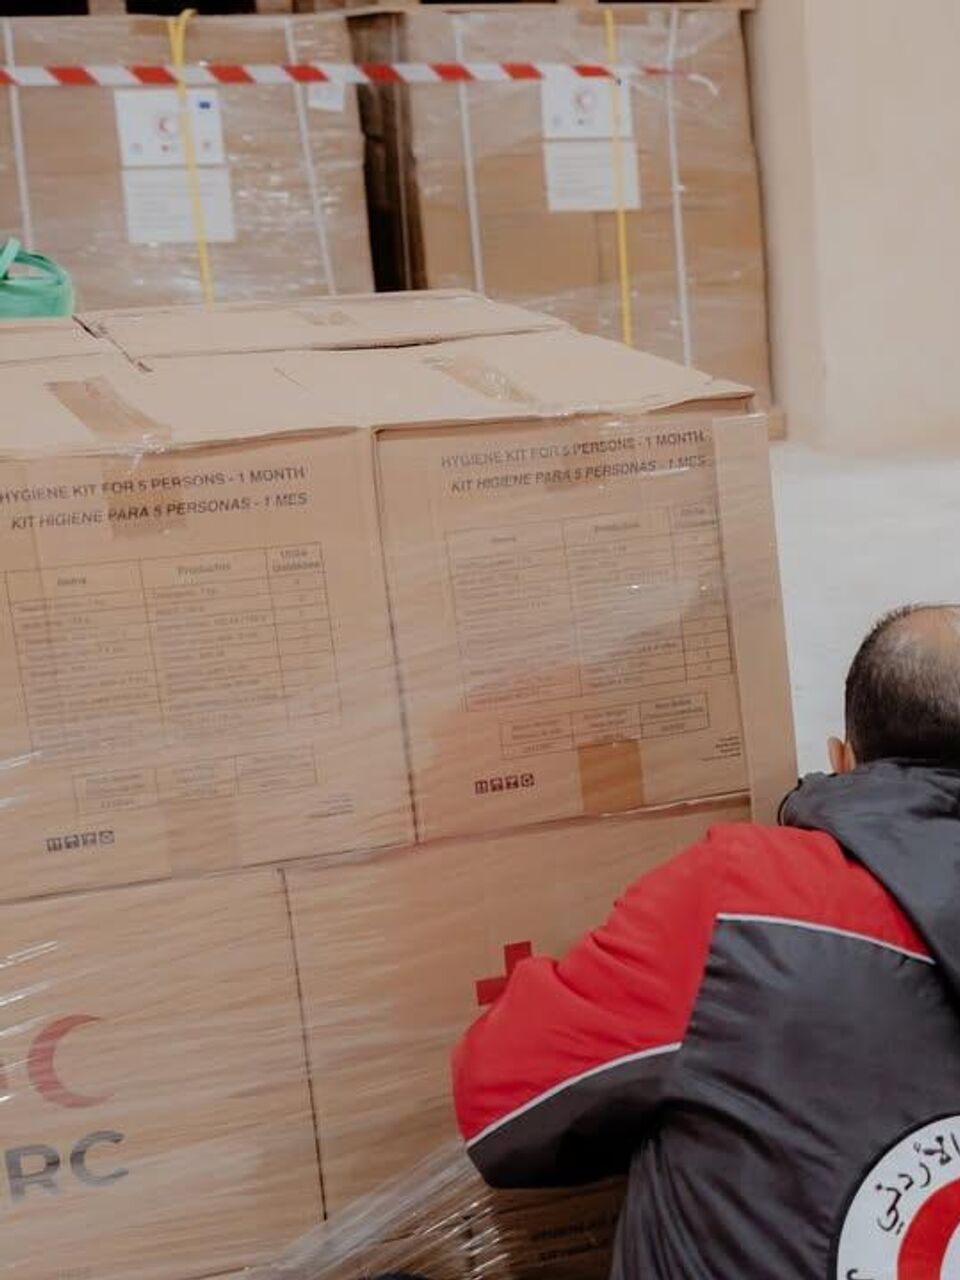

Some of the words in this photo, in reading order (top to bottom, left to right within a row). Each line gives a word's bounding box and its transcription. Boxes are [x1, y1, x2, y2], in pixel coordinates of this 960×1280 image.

[656, 429, 705, 446] MONTH
[71, 483, 97, 497] KIT
[101, 480, 134, 494] FOR
[151, 472, 225, 489] PERSONS
[249, 466, 305, 483] MONTH
[585, 460, 656, 479] PERSONAS
[11, 514, 34, 530] KIT
[39, 510, 103, 528] HIGIENE
[108, 505, 149, 522] PARA
[166, 497, 250, 516] PERSONAS
[275, 492, 308, 507] MES
